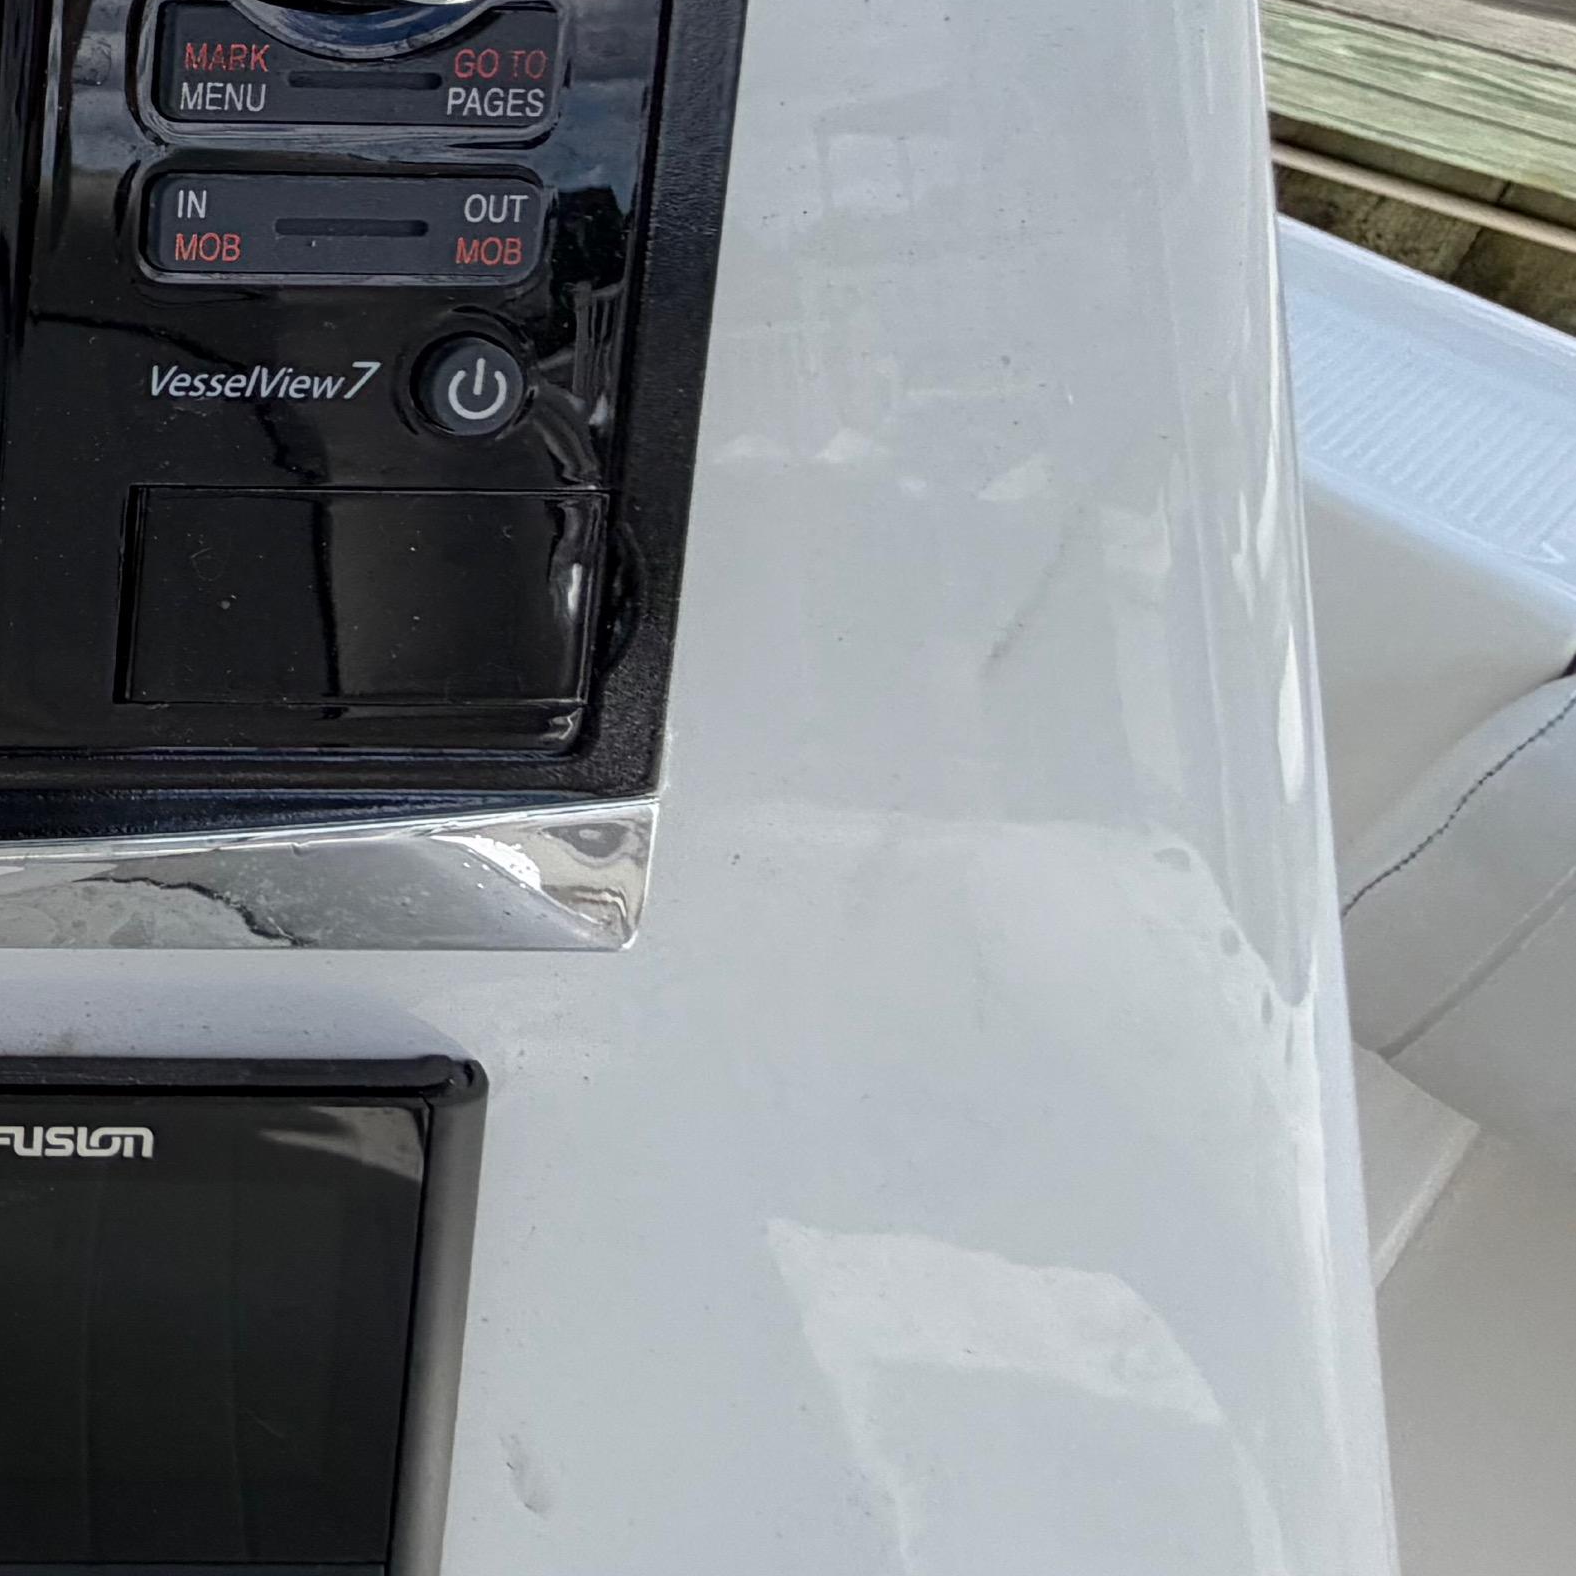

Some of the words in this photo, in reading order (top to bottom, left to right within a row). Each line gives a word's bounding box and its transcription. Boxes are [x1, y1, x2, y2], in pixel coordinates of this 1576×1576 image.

[184, 42, 270, 73] MARK
[453, 48, 500, 79] GO
[509, 49, 549, 80] TO
[179, 82, 267, 113] MENU
[447, 88, 546, 118] PAGES
[177, 190, 207, 219] IN
[463, 194, 529, 223] OUT
[174, 233, 242, 263] MOB
[455, 237, 523, 266] MOB
